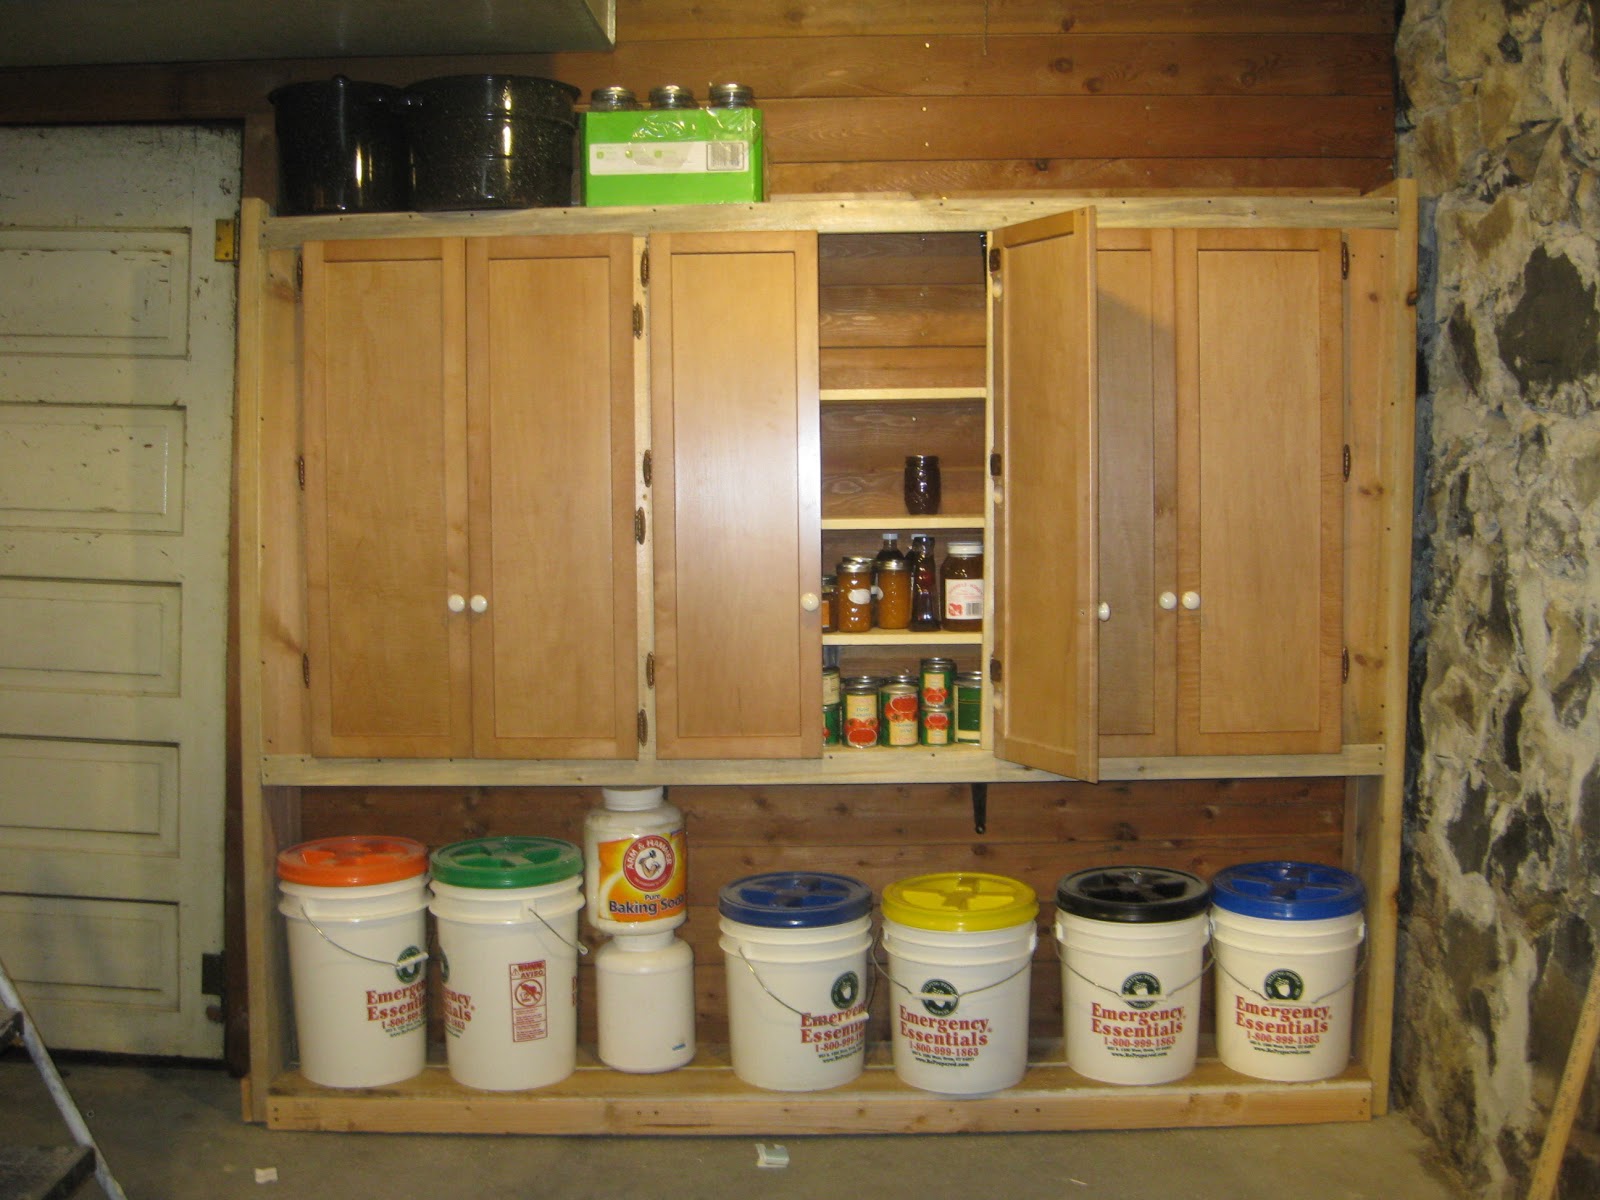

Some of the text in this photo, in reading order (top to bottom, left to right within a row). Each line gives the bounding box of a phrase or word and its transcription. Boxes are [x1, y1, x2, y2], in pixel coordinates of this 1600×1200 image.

[627, 849, 638, 869] ARM
[646, 839, 672, 865] HAMMER
[609, 900, 658, 915] Baking
[521, 970, 544, 978] AVISO
[899, 1004, 989, 1033] Emergency
[1091, 1002, 1184, 1026] Emergency
[1235, 994, 1330, 1022] Emergency
[899, 1020, 988, 1046] Essentials
[1091, 1017, 1183, 1038] Essentials
[1235, 1011, 1329, 1035] Essentials
[1104, 1036, 1176, 1048] 1-800-999-1863
[1247, 1030, 1320, 1044] 1-800-999-1863
[910, 1041, 979, 1057] 1-800-999-1863
